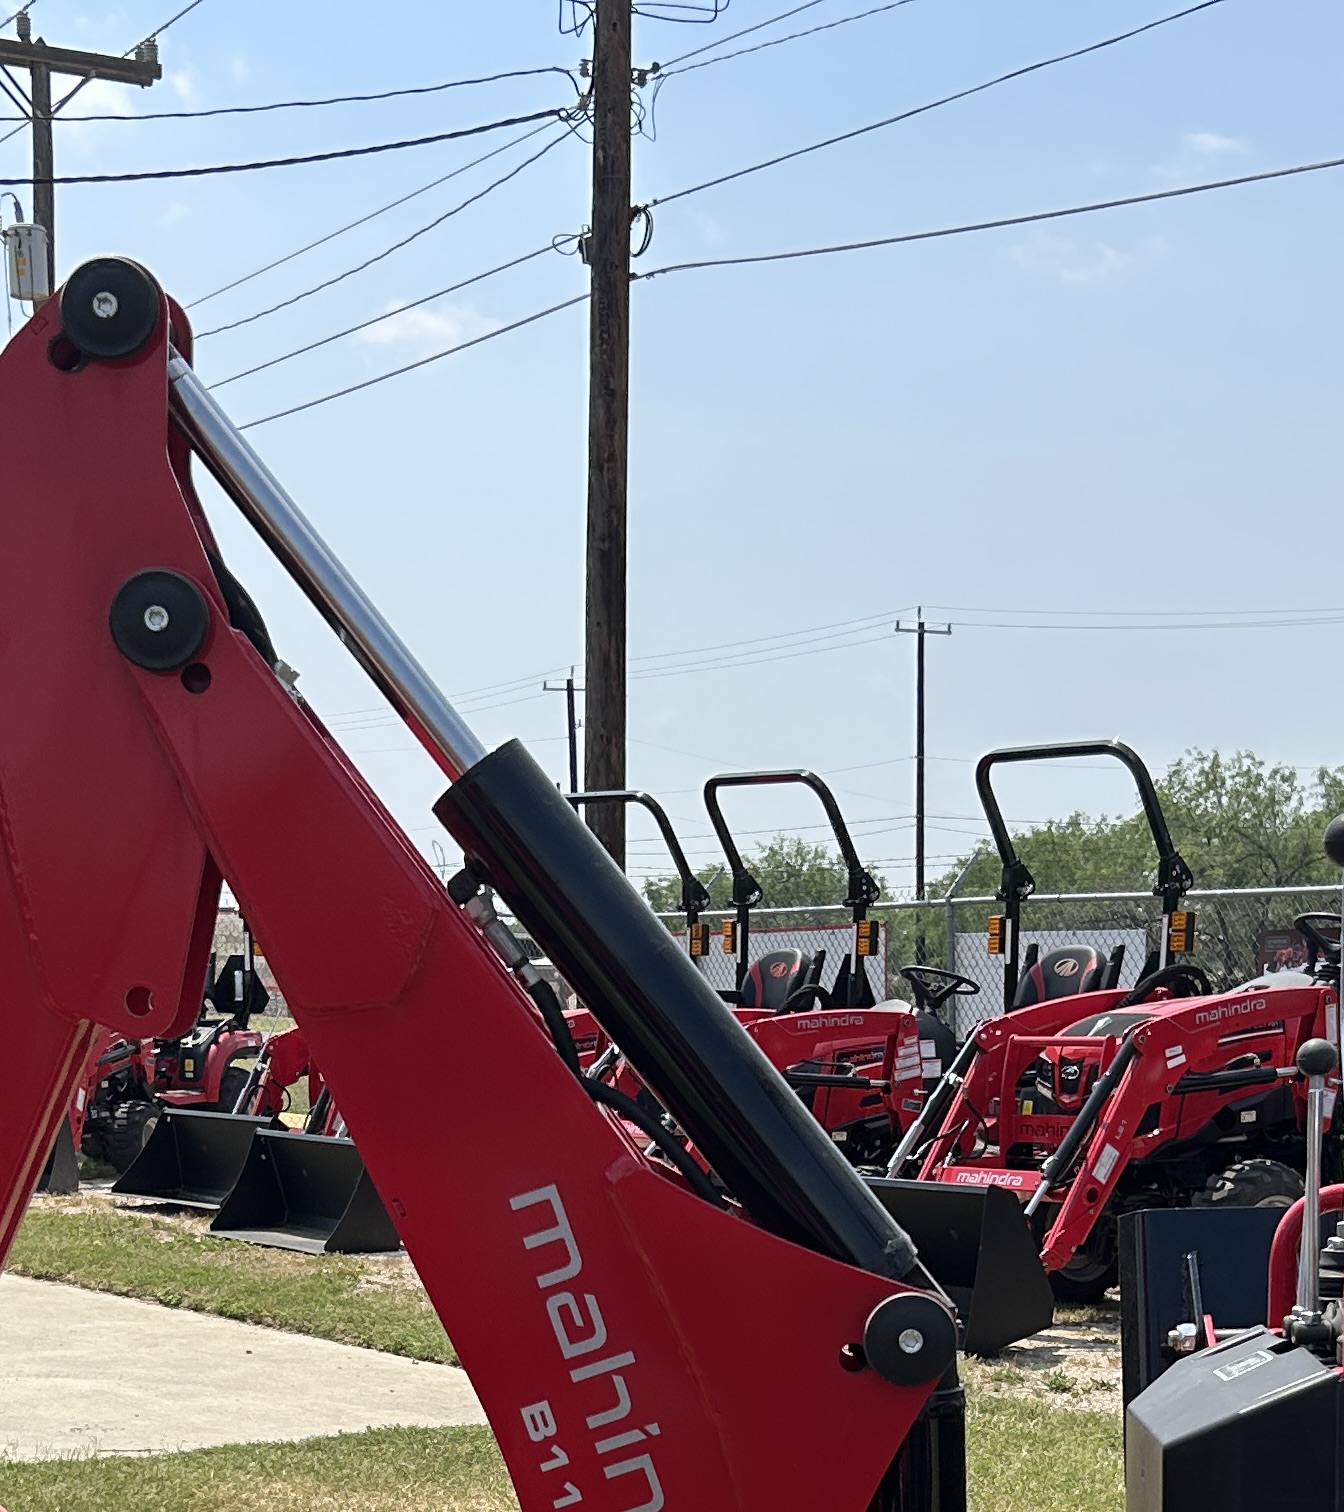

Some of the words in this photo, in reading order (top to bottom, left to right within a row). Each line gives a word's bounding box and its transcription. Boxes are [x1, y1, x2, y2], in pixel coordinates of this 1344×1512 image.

[1195, 998, 1267, 1025] mahindra
[797, 1014, 864, 1030] mahindra
[956, 1170, 1023, 1187] mahindra
